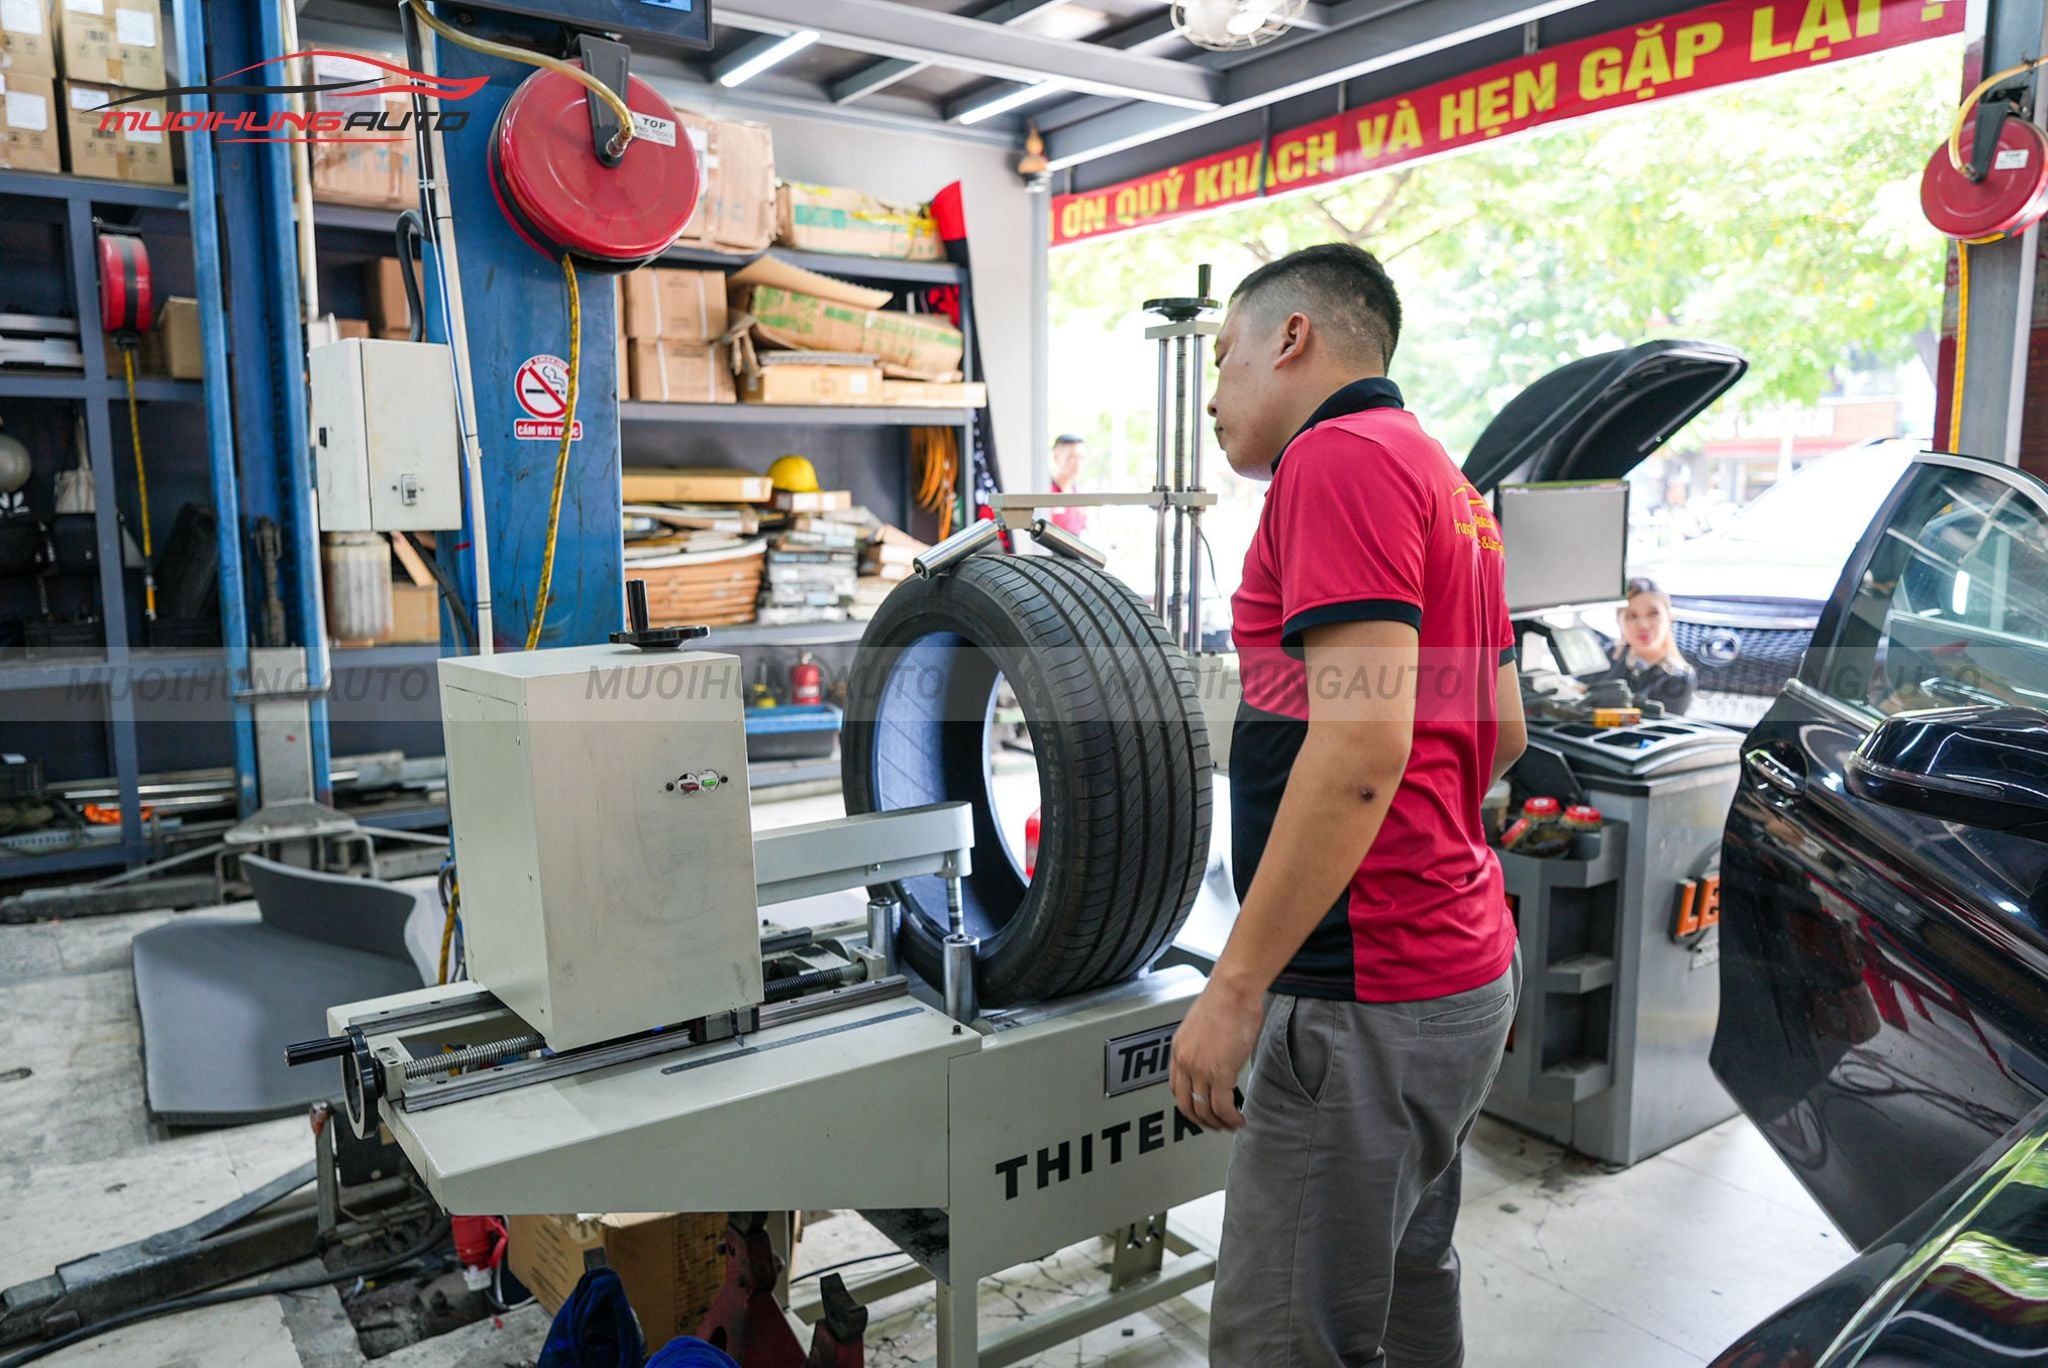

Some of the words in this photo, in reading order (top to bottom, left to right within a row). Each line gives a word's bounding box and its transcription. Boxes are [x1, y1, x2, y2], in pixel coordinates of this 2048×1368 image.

[642, 117, 667, 129] TOP
[1358, 99, 1422, 160] VÀ
[1440, 63, 1557, 140] HẸN
[1579, 22, 1724, 100] GẶP
[1751, 0, 1881, 61] LẠI
